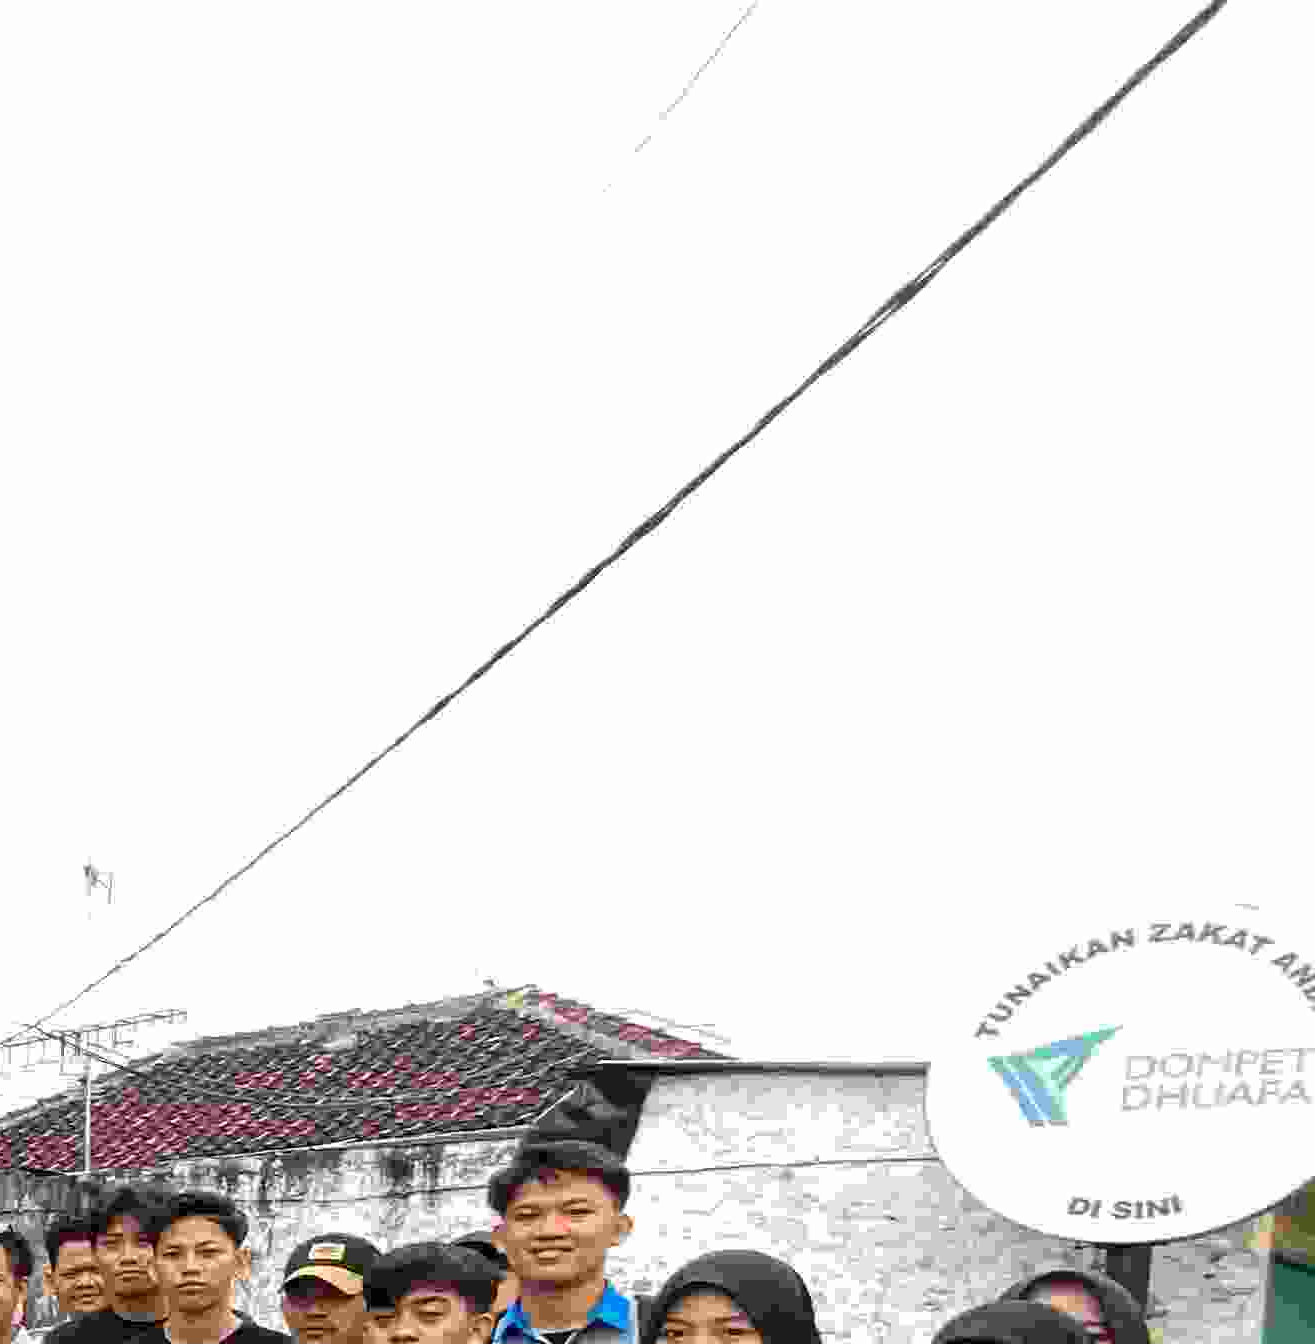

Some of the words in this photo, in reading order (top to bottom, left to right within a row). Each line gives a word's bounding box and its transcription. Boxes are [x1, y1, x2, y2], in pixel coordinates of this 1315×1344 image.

[973, 927, 1137, 1040] TUNAIKAN
[1147, 920, 1276, 958] ZAKAT
[1125, 1048, 1314, 1080] DOMPET
[1121, 1080, 1313, 1112] DHUAFA
[1067, 1195, 1102, 1219] DI
[1109, 1192, 1184, 1220] SINI
